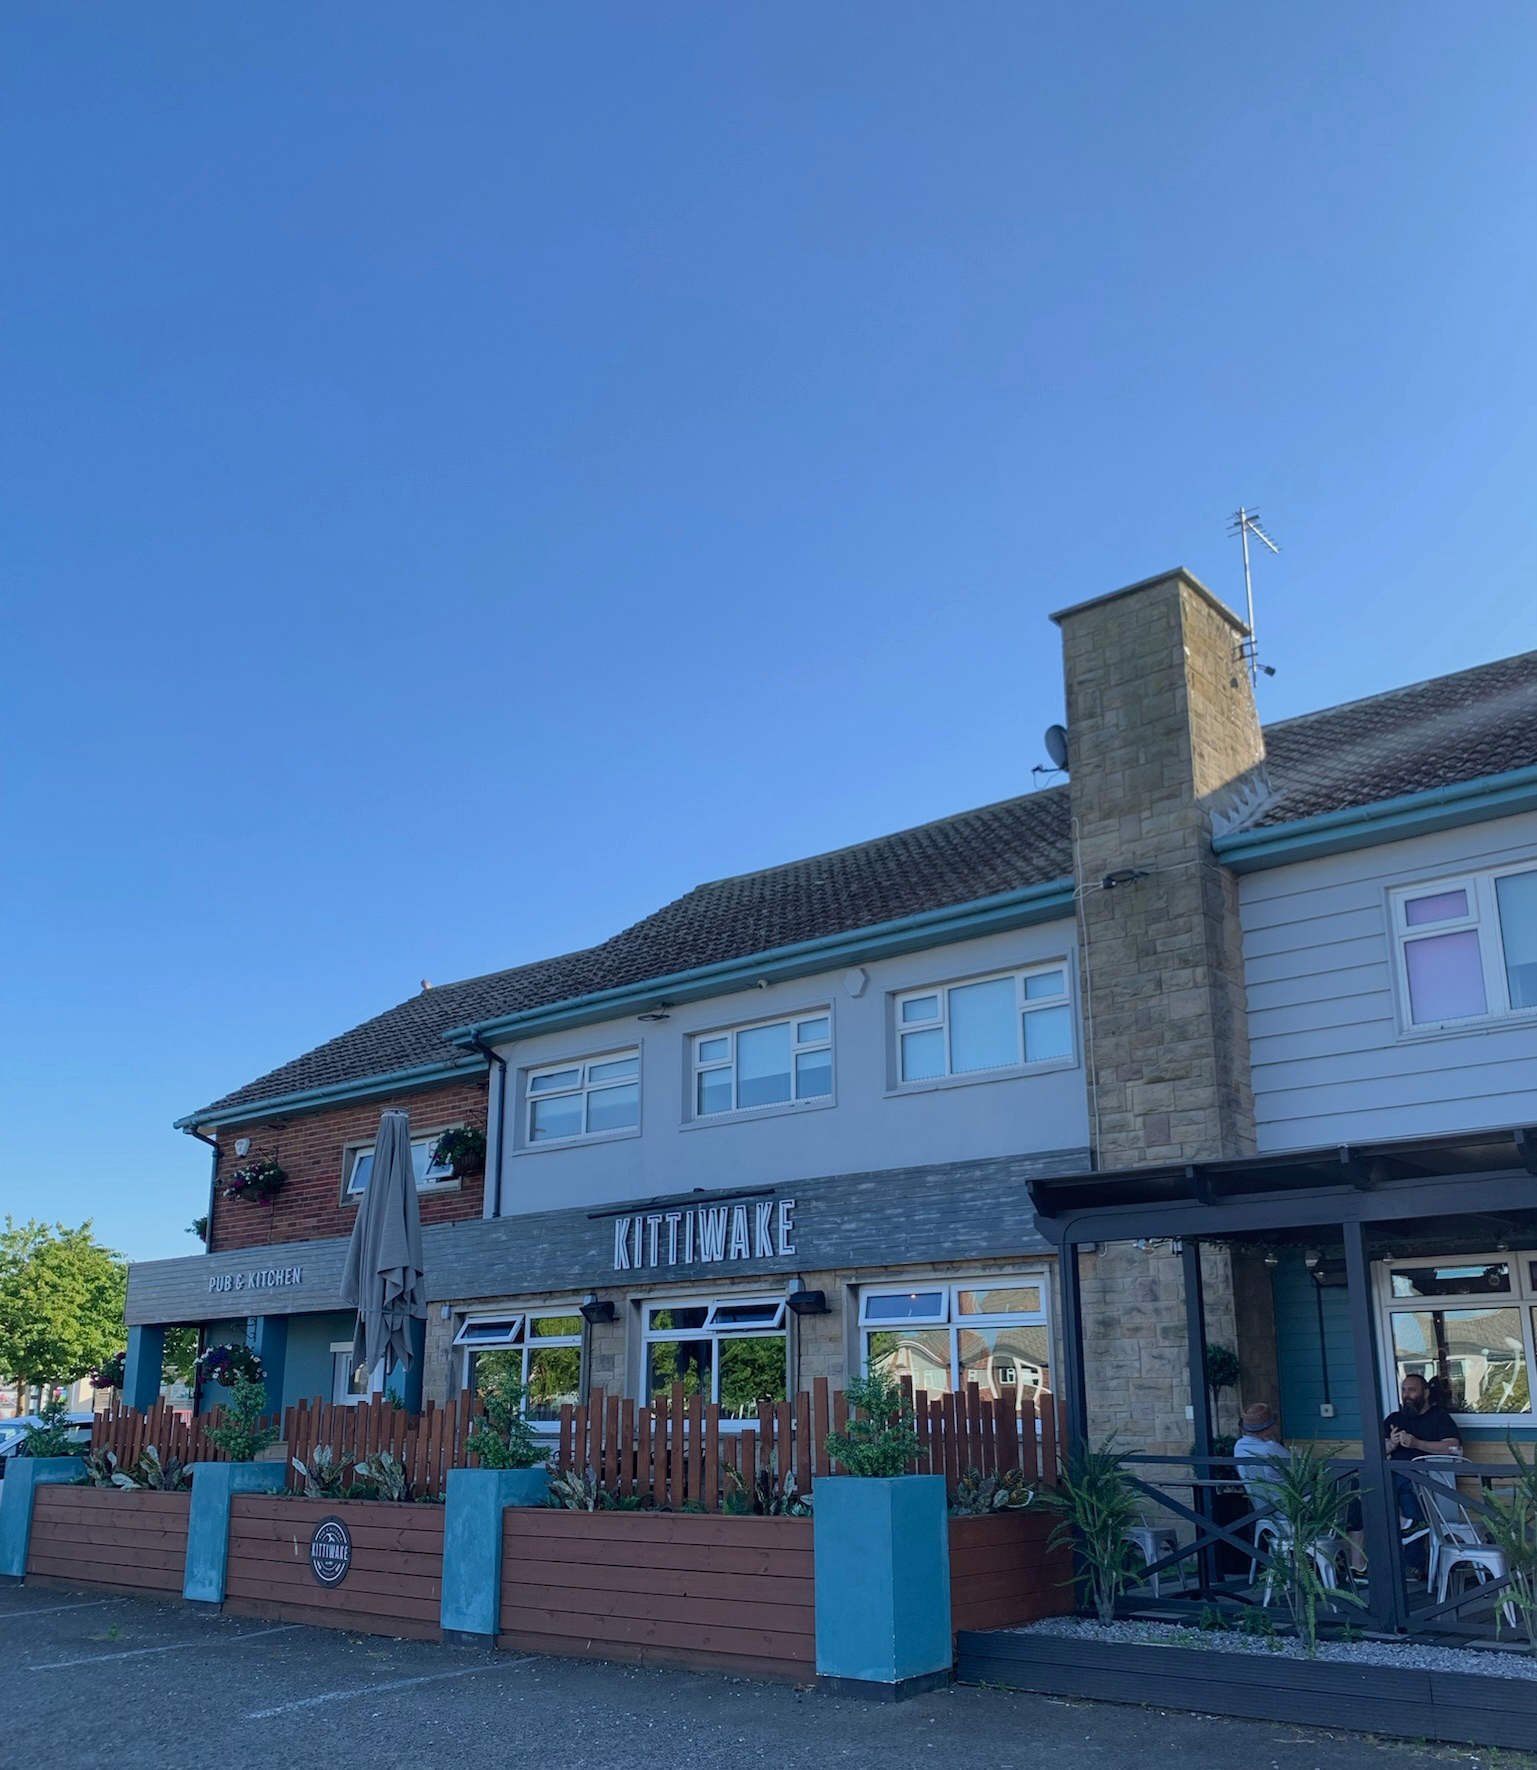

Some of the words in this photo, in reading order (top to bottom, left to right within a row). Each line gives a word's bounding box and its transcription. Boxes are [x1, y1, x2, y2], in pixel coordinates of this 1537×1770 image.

[613, 1200, 796, 1270] KITTIWAKE
[209, 1275, 231, 1292] PUB
[235, 1274, 244, 1289] &
[248, 1267, 302, 1288] KITCHEN
[311, 1542, 348, 1560] KITTIWAKE
